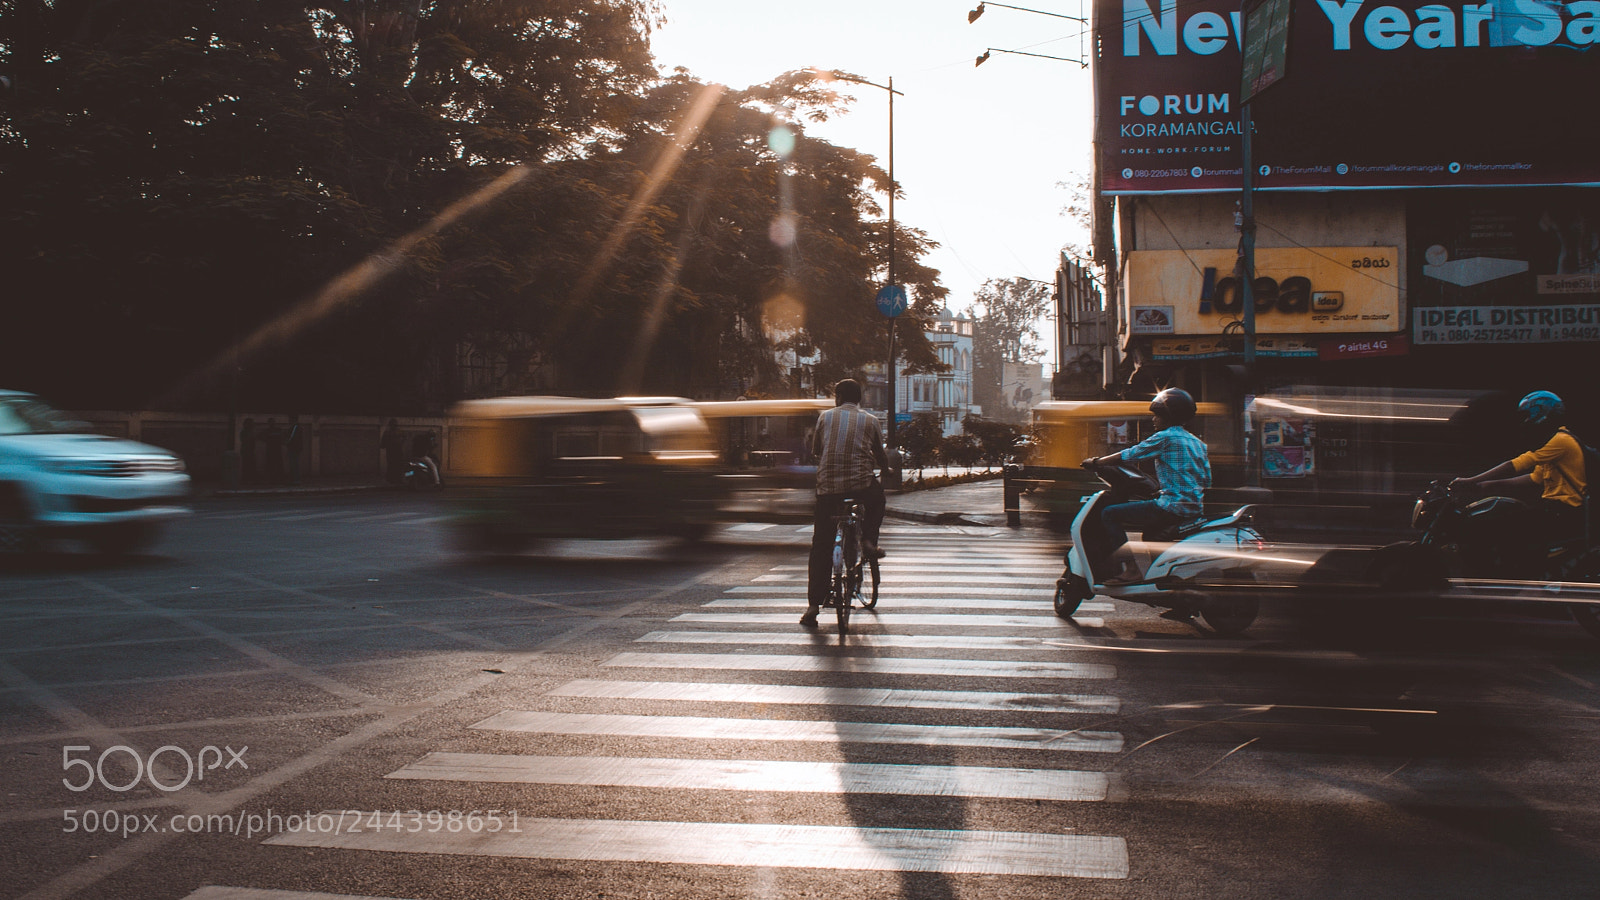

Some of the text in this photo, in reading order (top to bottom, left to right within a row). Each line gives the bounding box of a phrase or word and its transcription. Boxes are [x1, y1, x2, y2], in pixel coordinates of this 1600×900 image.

[1123, 0, 1241, 56] Ne
[1315, 0, 1494, 50] Year
[1120, 93, 1229, 116] FORUM
[1134, 168, 1188, 178] 080-22067803
[1420, 309, 1484, 327] IDEAL
[1422, 330, 1438, 342] Ph
[1447, 328, 1533, 341] 080-25725477
[1540, 328, 1551, 340] M
[1174, 343, 1191, 352] 4G
[1347, 340, 1388, 352] airtel 4G
[1321, 438, 1348, 447] STD
